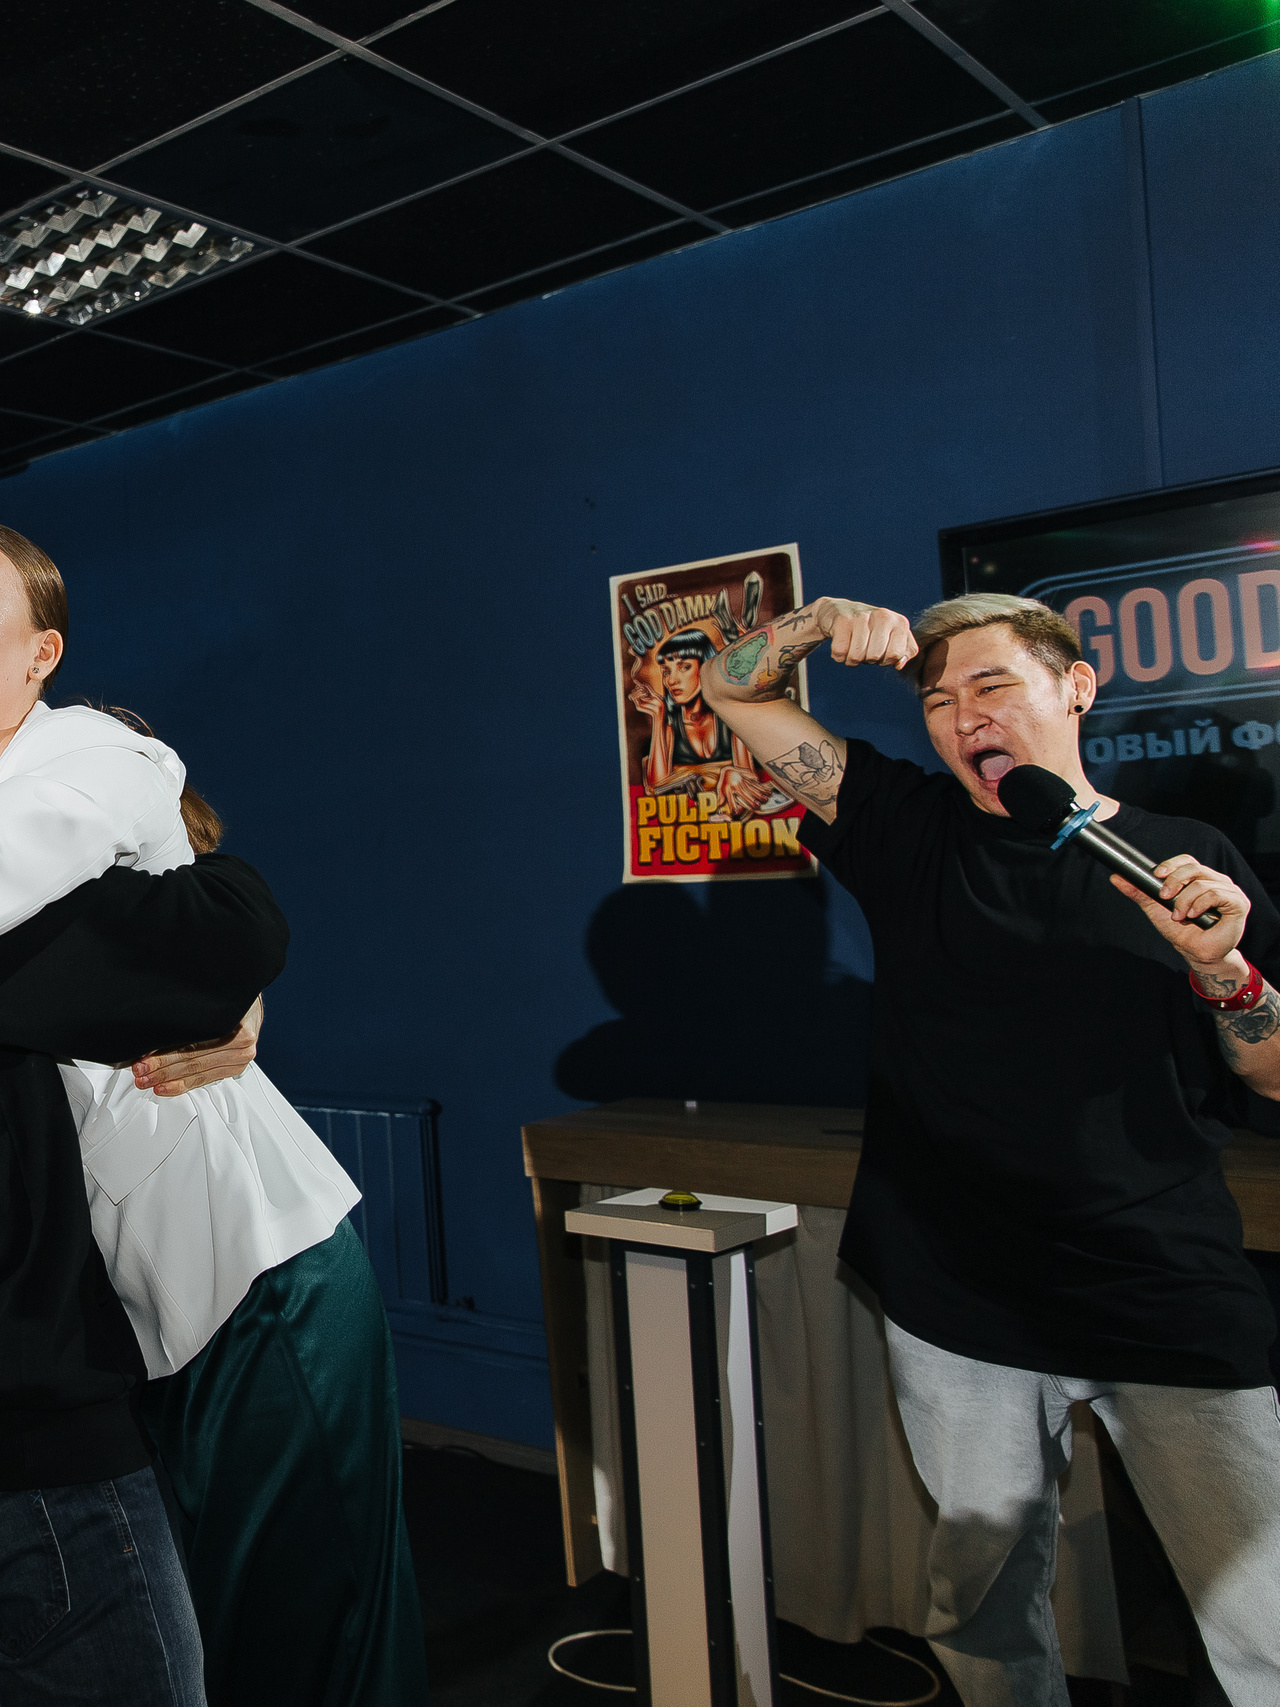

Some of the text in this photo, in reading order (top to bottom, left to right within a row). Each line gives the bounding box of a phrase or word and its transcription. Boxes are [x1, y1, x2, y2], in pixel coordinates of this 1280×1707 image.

[621, 593, 636, 616] I
[623, 608, 663, 655] GOD
[1064, 570, 1280, 687] GOOD
[1085, 719, 1220, 764] ОВЫЙ
[637, 791, 718, 826] PULP
[638, 817, 800, 863] FICTION
